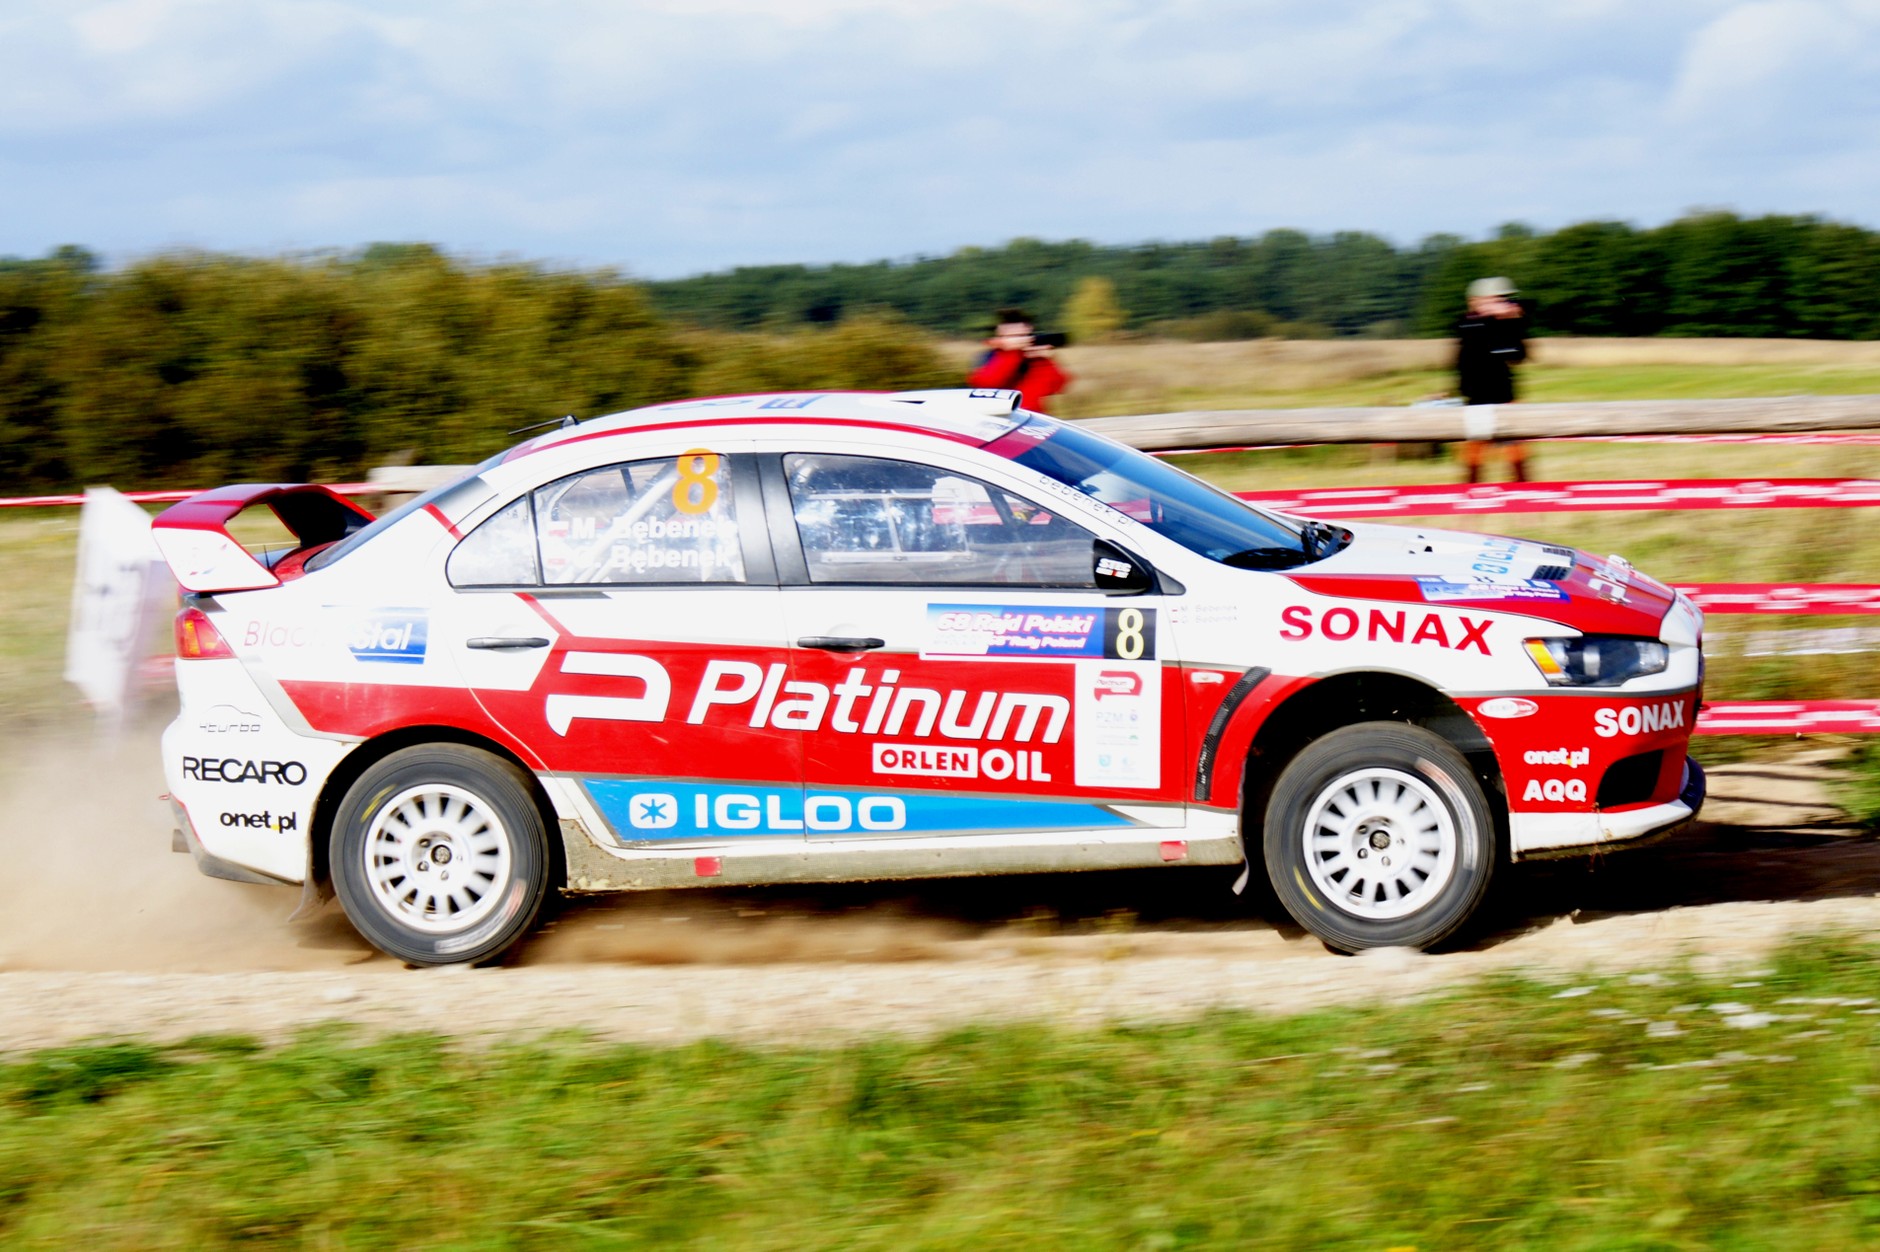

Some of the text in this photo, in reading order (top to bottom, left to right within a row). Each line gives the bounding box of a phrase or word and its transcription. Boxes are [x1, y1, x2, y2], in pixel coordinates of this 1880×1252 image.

[672, 448, 719, 515] 8
[938, 612, 1096, 635] 68 Rajd Polski
[1116, 608, 1144, 660] 8
[1279, 605, 1495, 657] SONAX
[1041, 636, 1086, 648] Poland
[686, 659, 1071, 745] Platinum
[1594, 700, 1685, 738] SONAX
[182, 756, 308, 786] RECARO
[880, 748, 1052, 782] ORLEN OIL
[1524, 747, 1590, 769] onet.pl
[1522, 778, 1587, 803] AQQ
[220, 811, 297, 834] onet.pl
[695, 793, 907, 831] IGLOO
